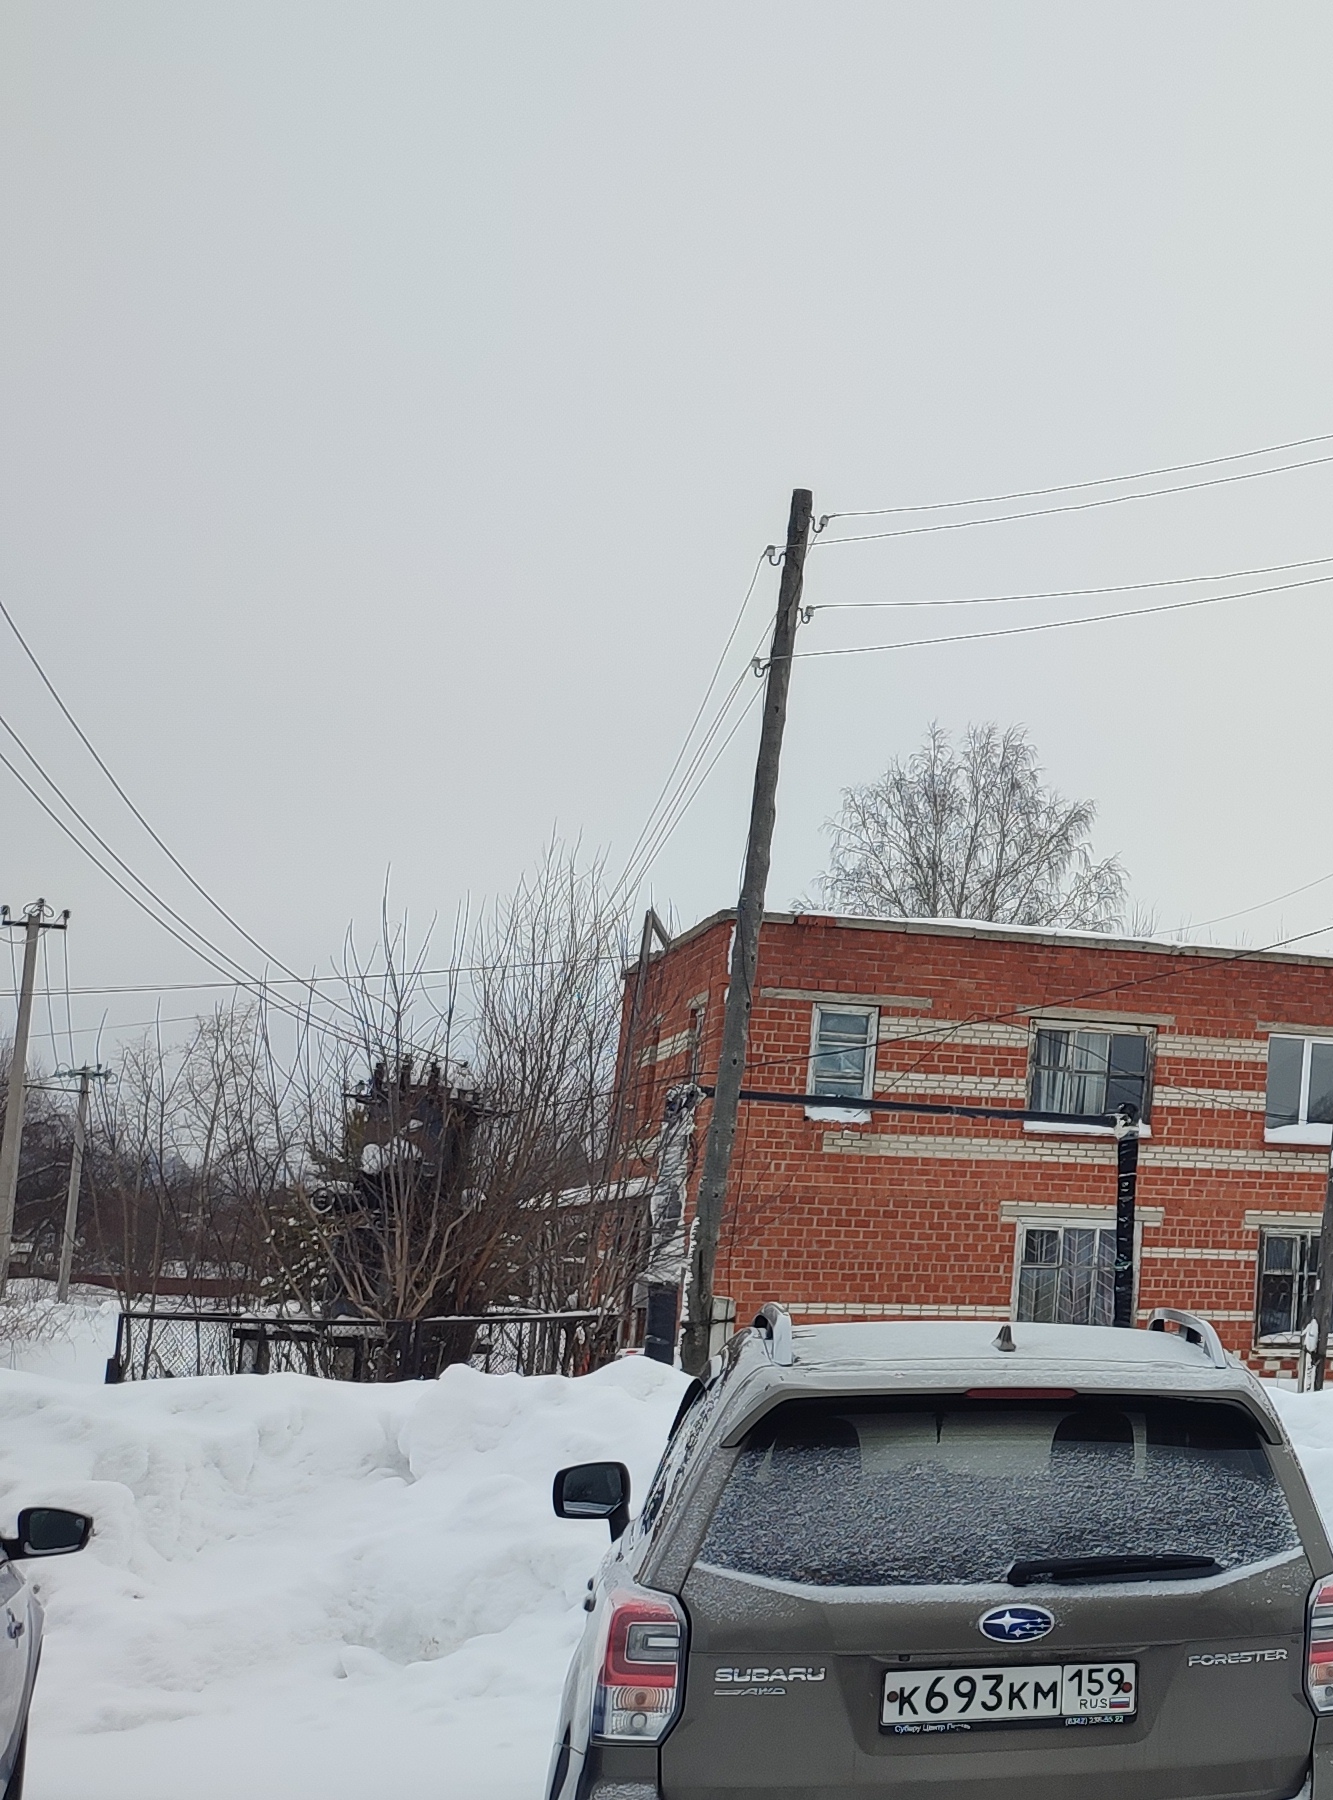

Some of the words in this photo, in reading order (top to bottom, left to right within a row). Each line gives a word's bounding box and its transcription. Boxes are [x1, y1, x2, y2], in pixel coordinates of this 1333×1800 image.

[1188, 1648, 1289, 1667] FORESTER
[714, 1667, 826, 1682] SUBARU
[1067, 1667, 1126, 1697] 159
[1079, 1697, 1108, 1710] RUS
